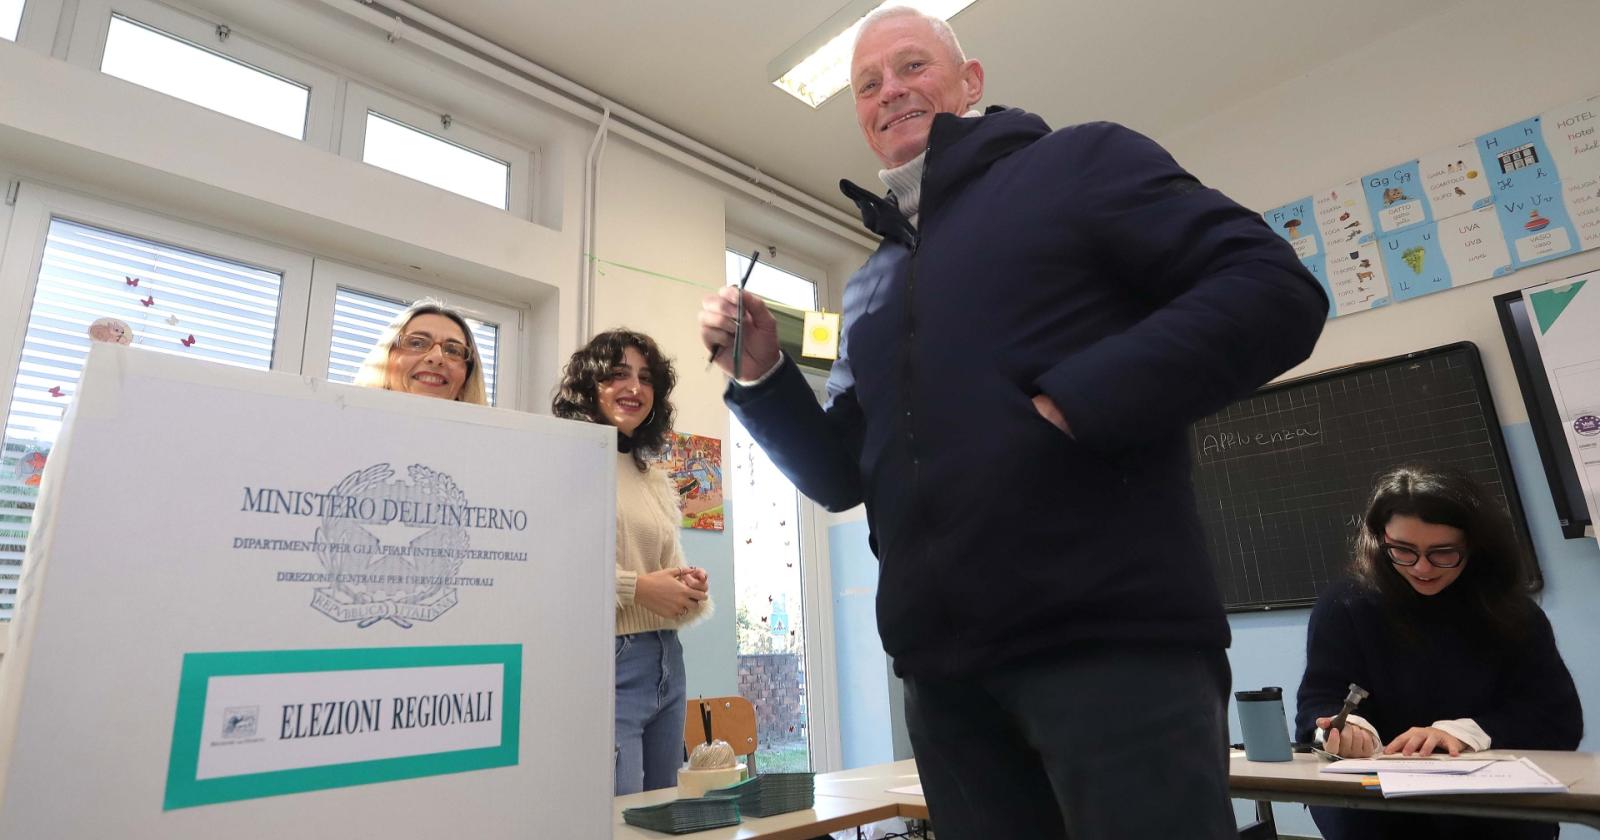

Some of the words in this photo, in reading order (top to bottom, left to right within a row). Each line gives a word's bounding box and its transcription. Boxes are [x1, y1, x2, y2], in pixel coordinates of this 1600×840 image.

[1557, 111, 1598, 129] HOTEL
[1458, 223, 1481, 234] UVA
[1388, 240, 1399, 250] U
[240, 486, 376, 521] MINISTERO
[382, 498, 528, 531] DELL'INTERNO
[233, 537, 328, 553] DIPARTIMENTO
[329, 542, 351, 554] PER
[353, 544, 372, 554] GLI
[375, 544, 411, 557] AFFARI
[413, 547, 455, 559] INTERNI
[465, 549, 528, 562] TERRITORIALI
[277, 571, 334, 583] DIREZIONE
[336, 573, 385, 585] CENTRALE
[387, 575, 405, 585] PER
[411, 576, 444, 585] SERVIZI
[444, 576, 494, 587] ELETTORALI
[398, 595, 455, 619] ITALIANA
[279, 698, 382, 740] ELEZIONI
[391, 690, 494, 731] REGIONALI
